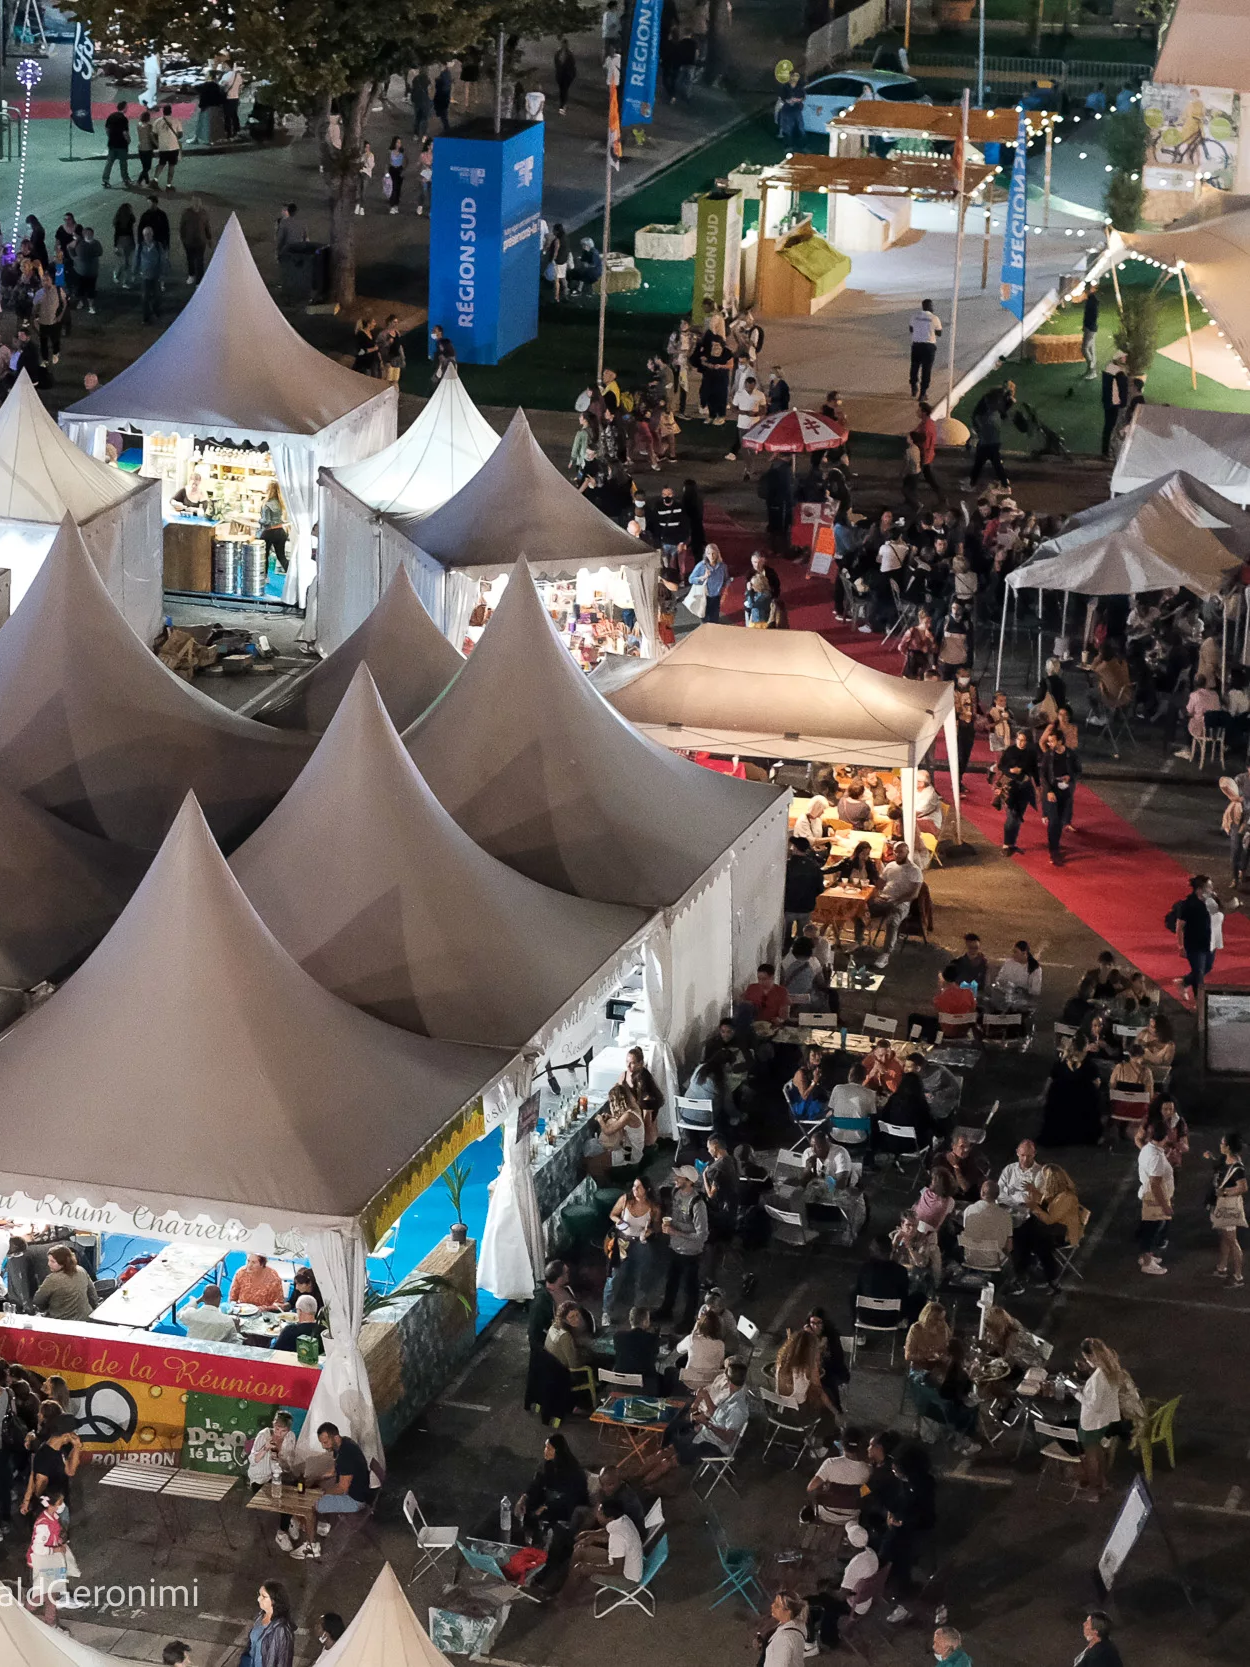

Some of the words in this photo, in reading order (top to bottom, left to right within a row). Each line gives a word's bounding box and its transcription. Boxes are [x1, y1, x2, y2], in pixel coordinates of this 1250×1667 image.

[460, 197, 477, 242] SUD
[706, 213, 719, 244] SUD
[455, 246, 476, 328] RÉGION
[91, 1349, 123, 1375] de
[129, 1351, 157, 1380] la
[163, 1356, 290, 1399] Réunion
[90, 1451, 176, 1468] BOURBON
[189, 1447, 204, 1459] lé
[206, 1448, 232, 1463] La
